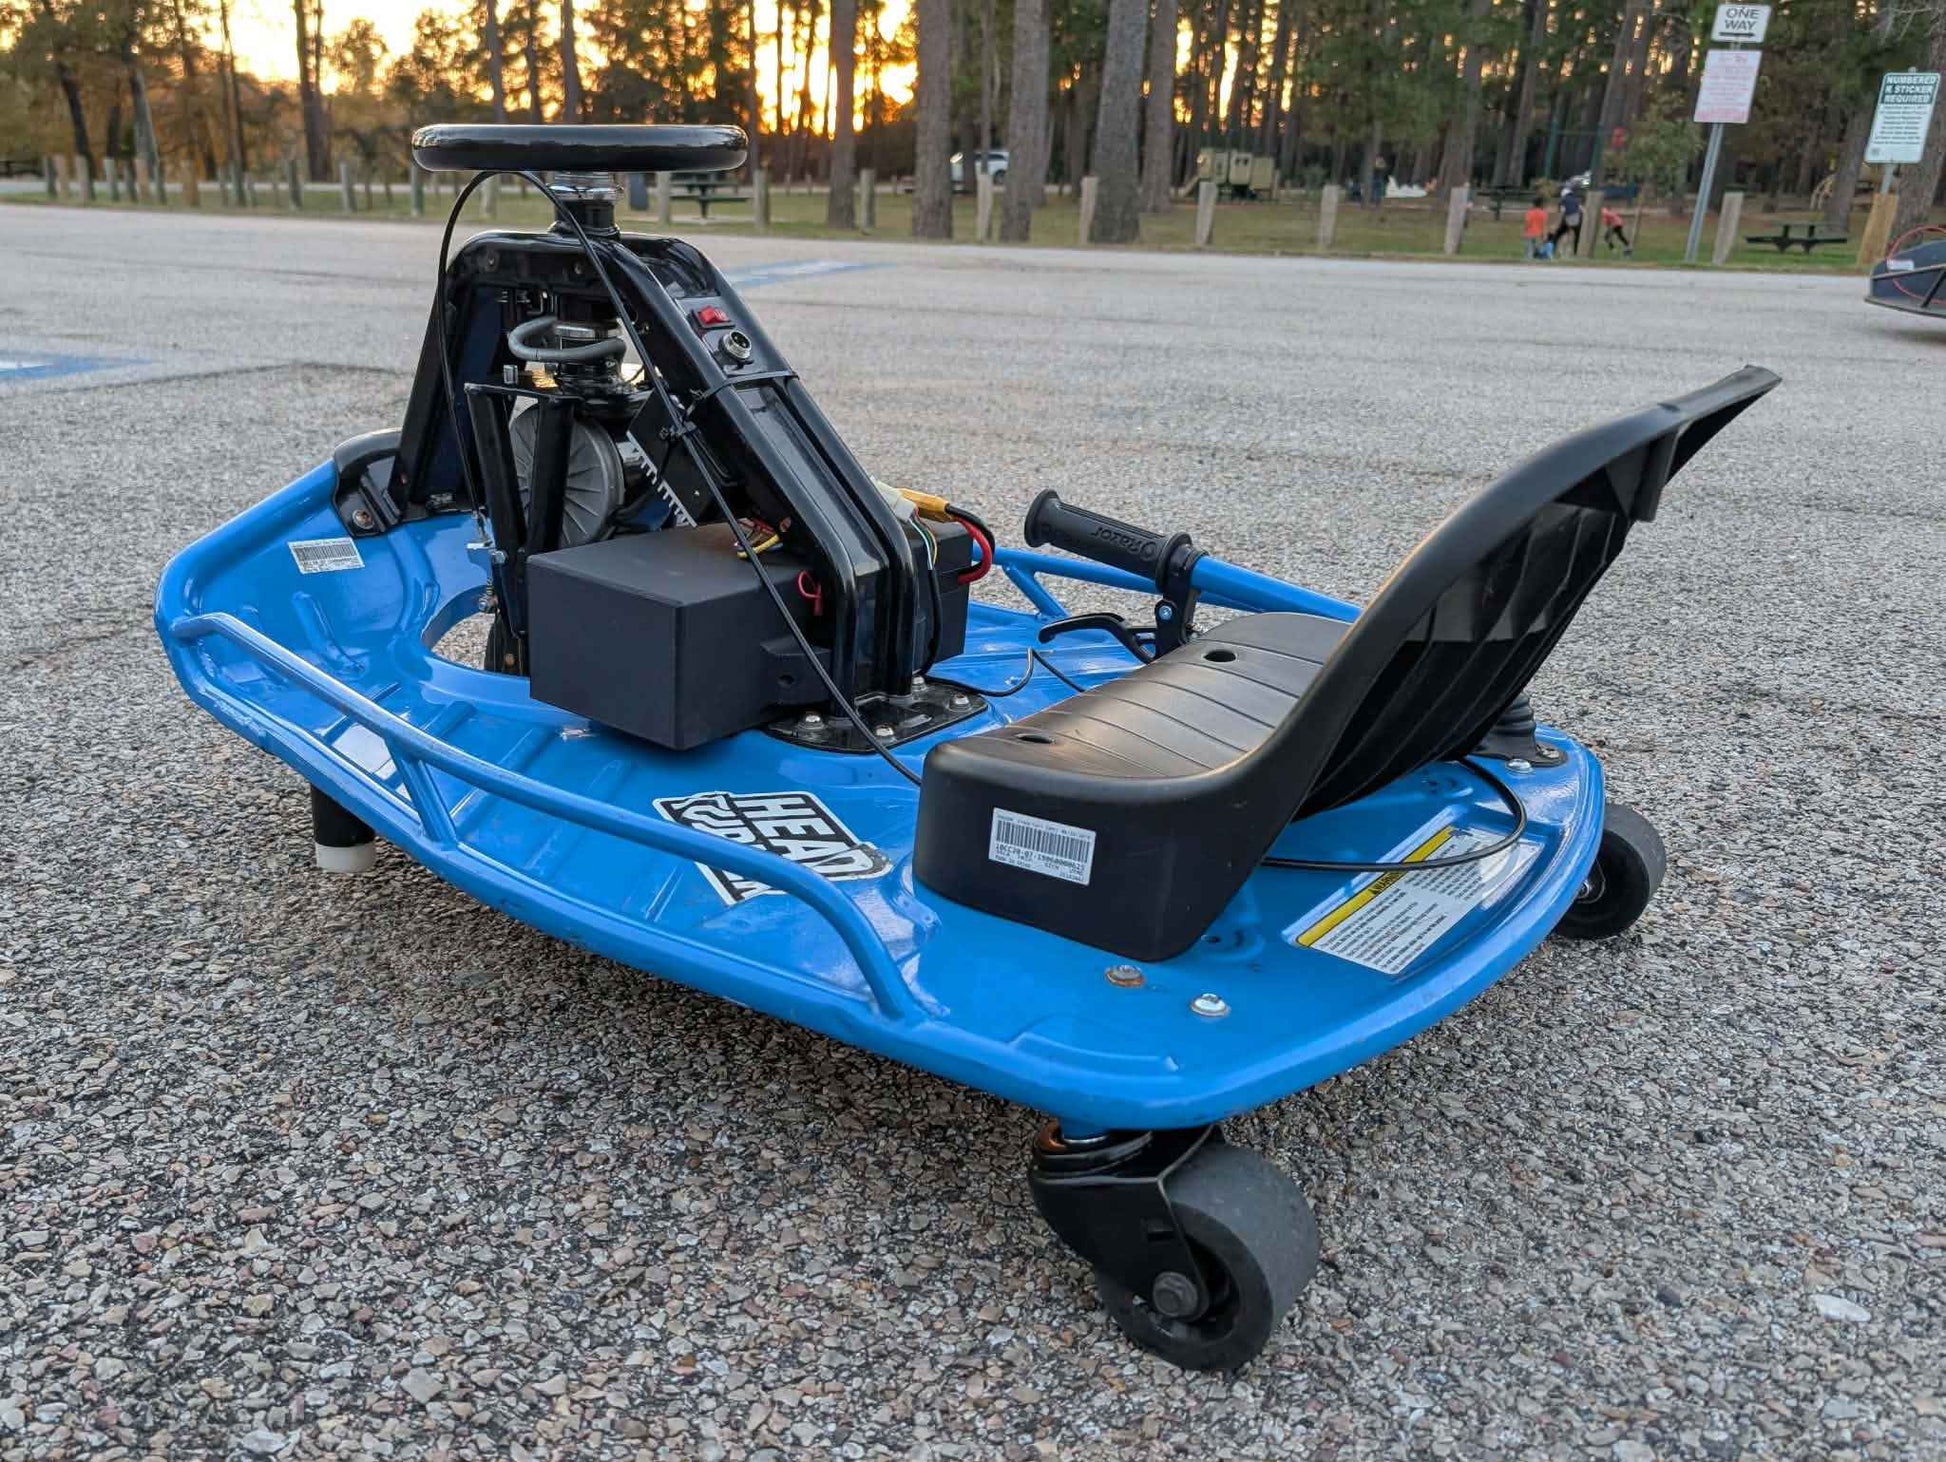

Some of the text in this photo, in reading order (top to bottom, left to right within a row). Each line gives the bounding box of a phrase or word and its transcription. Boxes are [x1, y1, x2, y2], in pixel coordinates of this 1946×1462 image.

[1726, 8, 1760, 19] ONE
[1725, 20, 1757, 30] WAY
[1886, 76, 1937, 84] NUMBERED
[1894, 85, 1934, 94] STICKER
[1884, 94, 1931, 103] REQUIRED
[733, 797, 874, 873] HEAD
